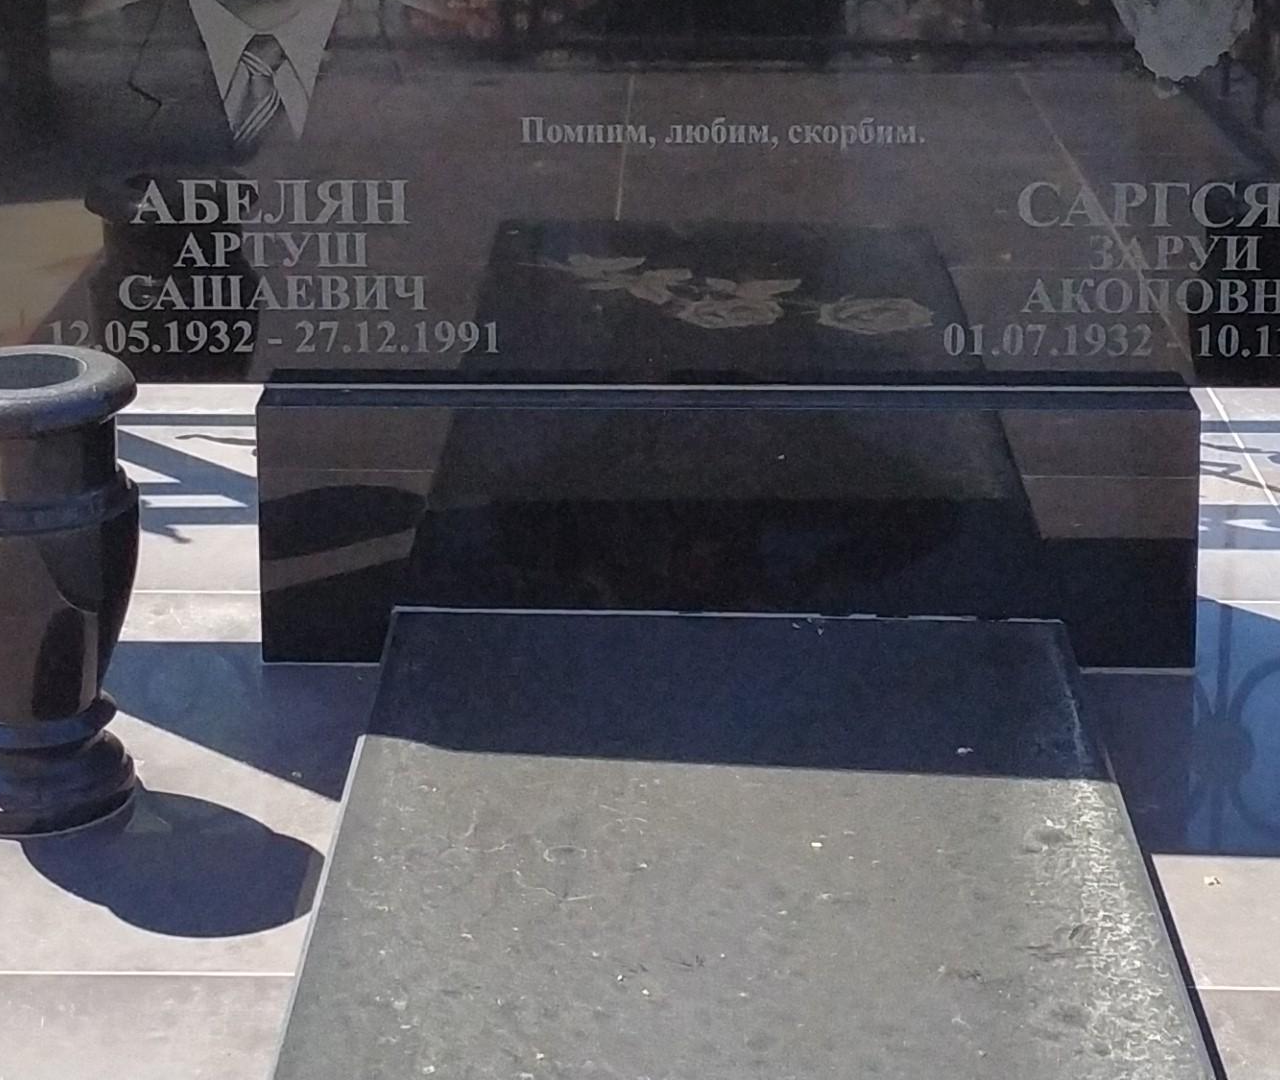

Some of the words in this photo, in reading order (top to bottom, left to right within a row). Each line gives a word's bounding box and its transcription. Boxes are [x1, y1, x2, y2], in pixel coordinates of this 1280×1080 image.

[520, 116, 657, 150] Помним,
[664, 118, 778, 150] любим,
[787, 118, 926, 151] скорбим.
[129, 178, 410, 225] АБЕЛЯН
[174, 231, 368, 268] АРТУШ
[1089, 235, 1262, 272] ЗАРУИ
[119, 274, 427, 312] САШАЕВИЧ
[48, 319, 254, 353] 12.05.1932
[295, 320, 500, 354] 27.12.1991
[943, 323, 1153, 357] 01.07.1932
